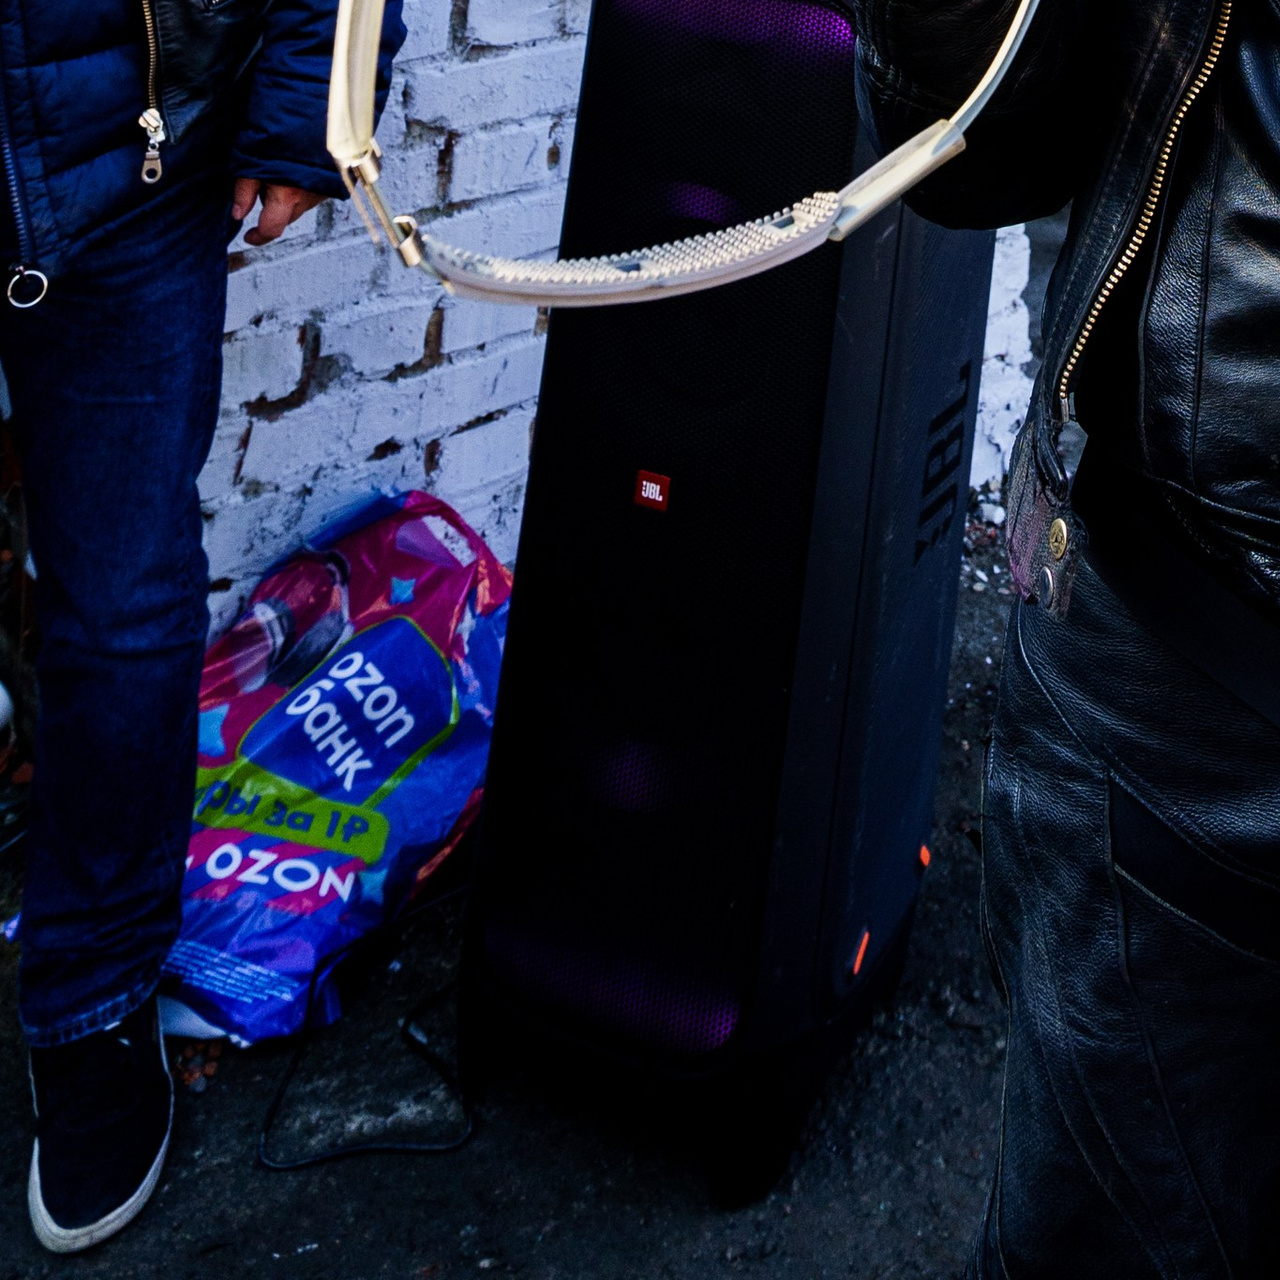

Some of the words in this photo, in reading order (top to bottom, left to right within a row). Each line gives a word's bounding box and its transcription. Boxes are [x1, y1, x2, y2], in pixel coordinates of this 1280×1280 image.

[641, 480, 664, 502] JBL
[328, 651, 415, 749] ozon
[285, 679, 373, 793] банк
[263, 800, 315, 833] за
[205, 842, 356, 904] OZON
